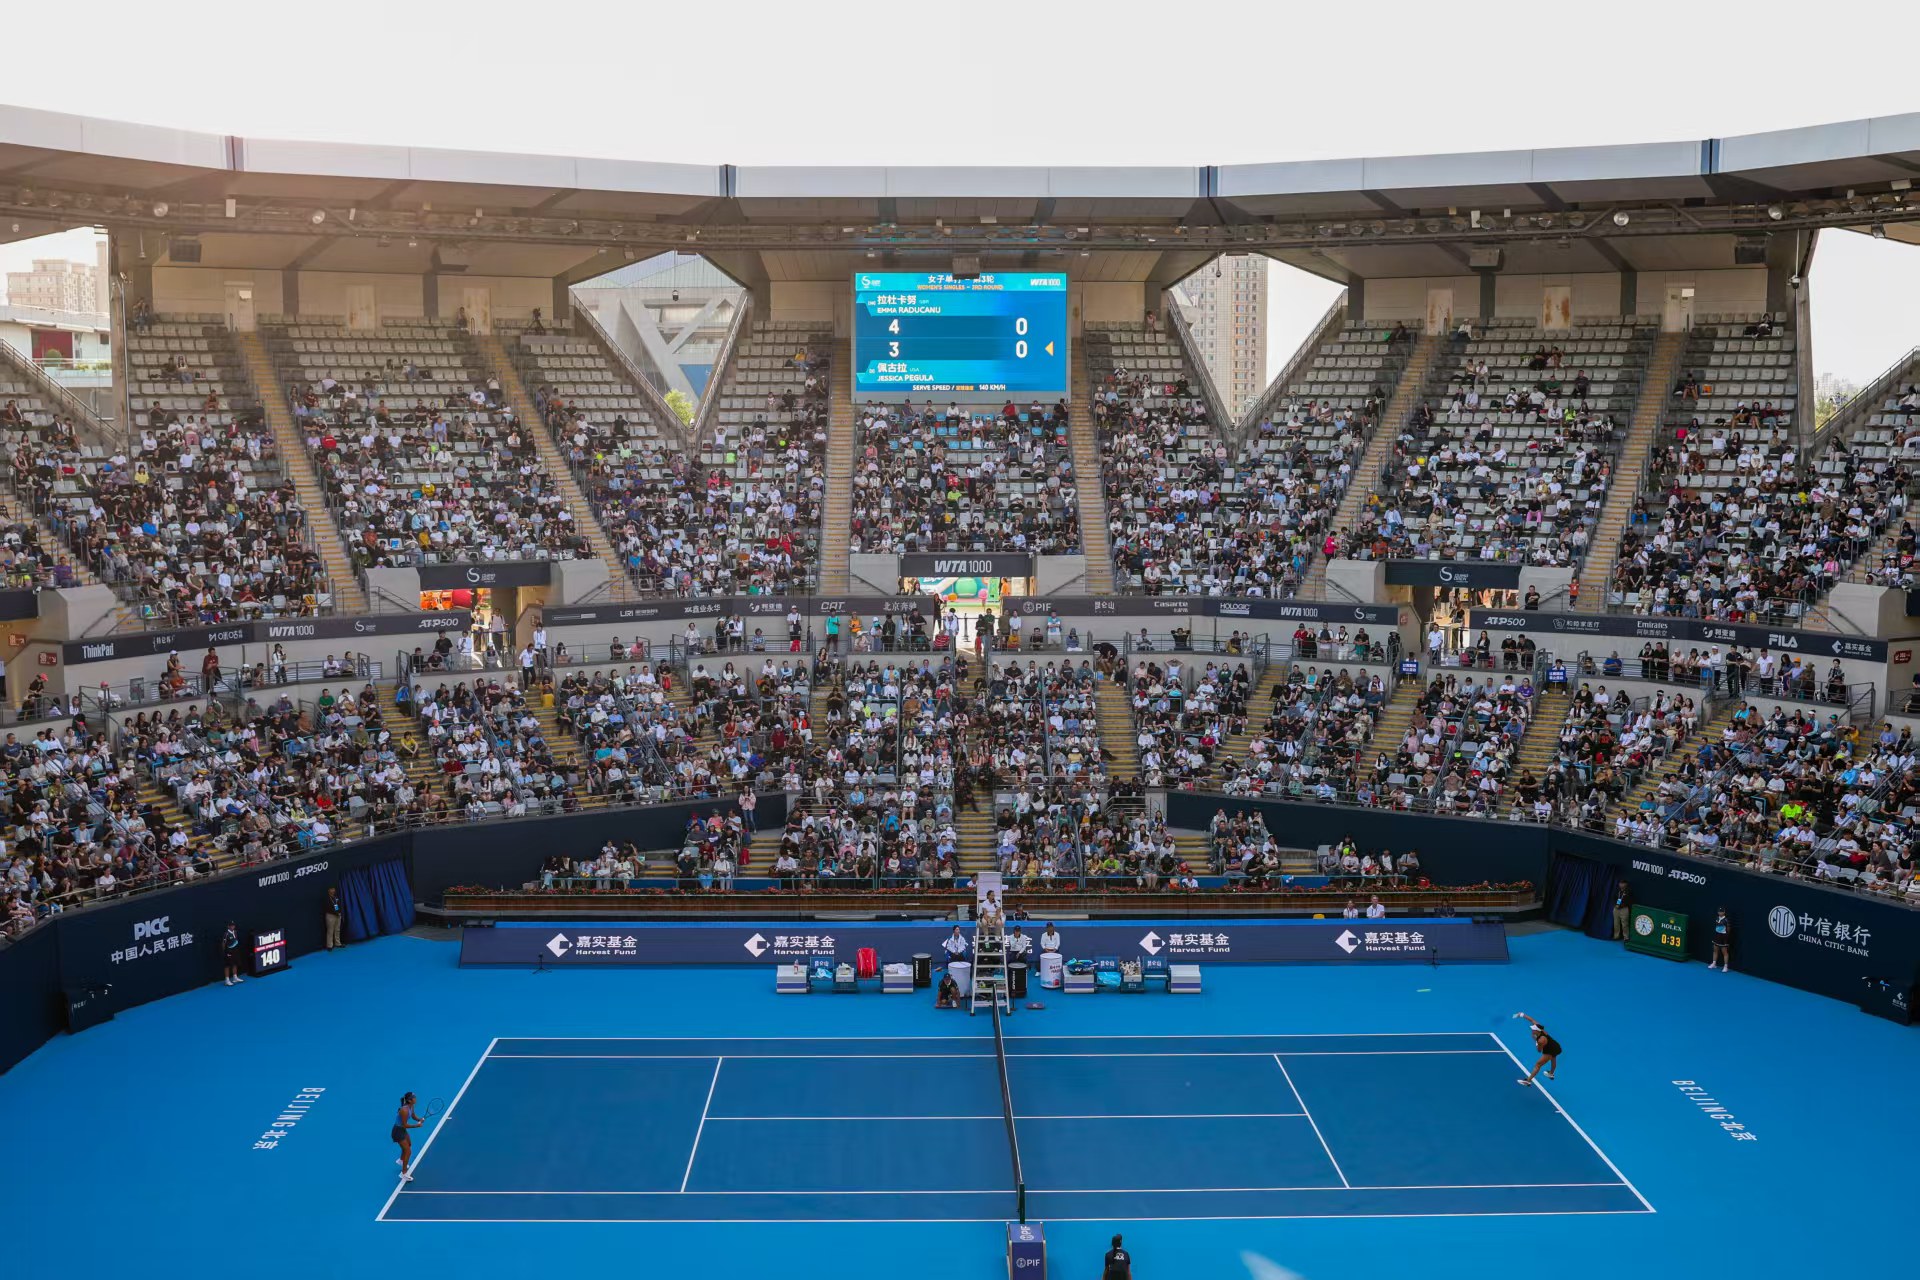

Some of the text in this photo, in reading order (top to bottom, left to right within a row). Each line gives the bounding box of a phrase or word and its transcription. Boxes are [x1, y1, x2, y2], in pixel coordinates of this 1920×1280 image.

[927, 274, 962, 284] 女子单
[877, 294, 916, 305] 拉杜卡努
[888, 319, 900, 334] 4
[1015, 317, 1028, 336] 0
[888, 342, 900, 358] 3
[1015, 340, 1028, 358] 0
[877, 362, 908, 373] 佩古拉
[1637, 620, 1668, 629] Emirates
[1768, 634, 1798, 648] FILA
[82, 642, 114, 659] ThinkPad
[134, 916, 170, 940] PICC
[1661, 922, 1682, 932] ROLEX
[1798, 912, 1872, 946] 中信银行
[576, 935, 638, 948] 嘉实基金
[774, 935, 835, 948] 嘉实基金
[1169, 934, 1229, 946] 嘉实基金
[1364, 932, 1425, 944] 嘉实基金
[1798, 933, 1870, 957] CHINA CITIC BANK
[110, 932, 193, 964] 中国人民保险
[260, 948, 280, 966] 140
[1026, 1258, 1040, 1267] PIF
